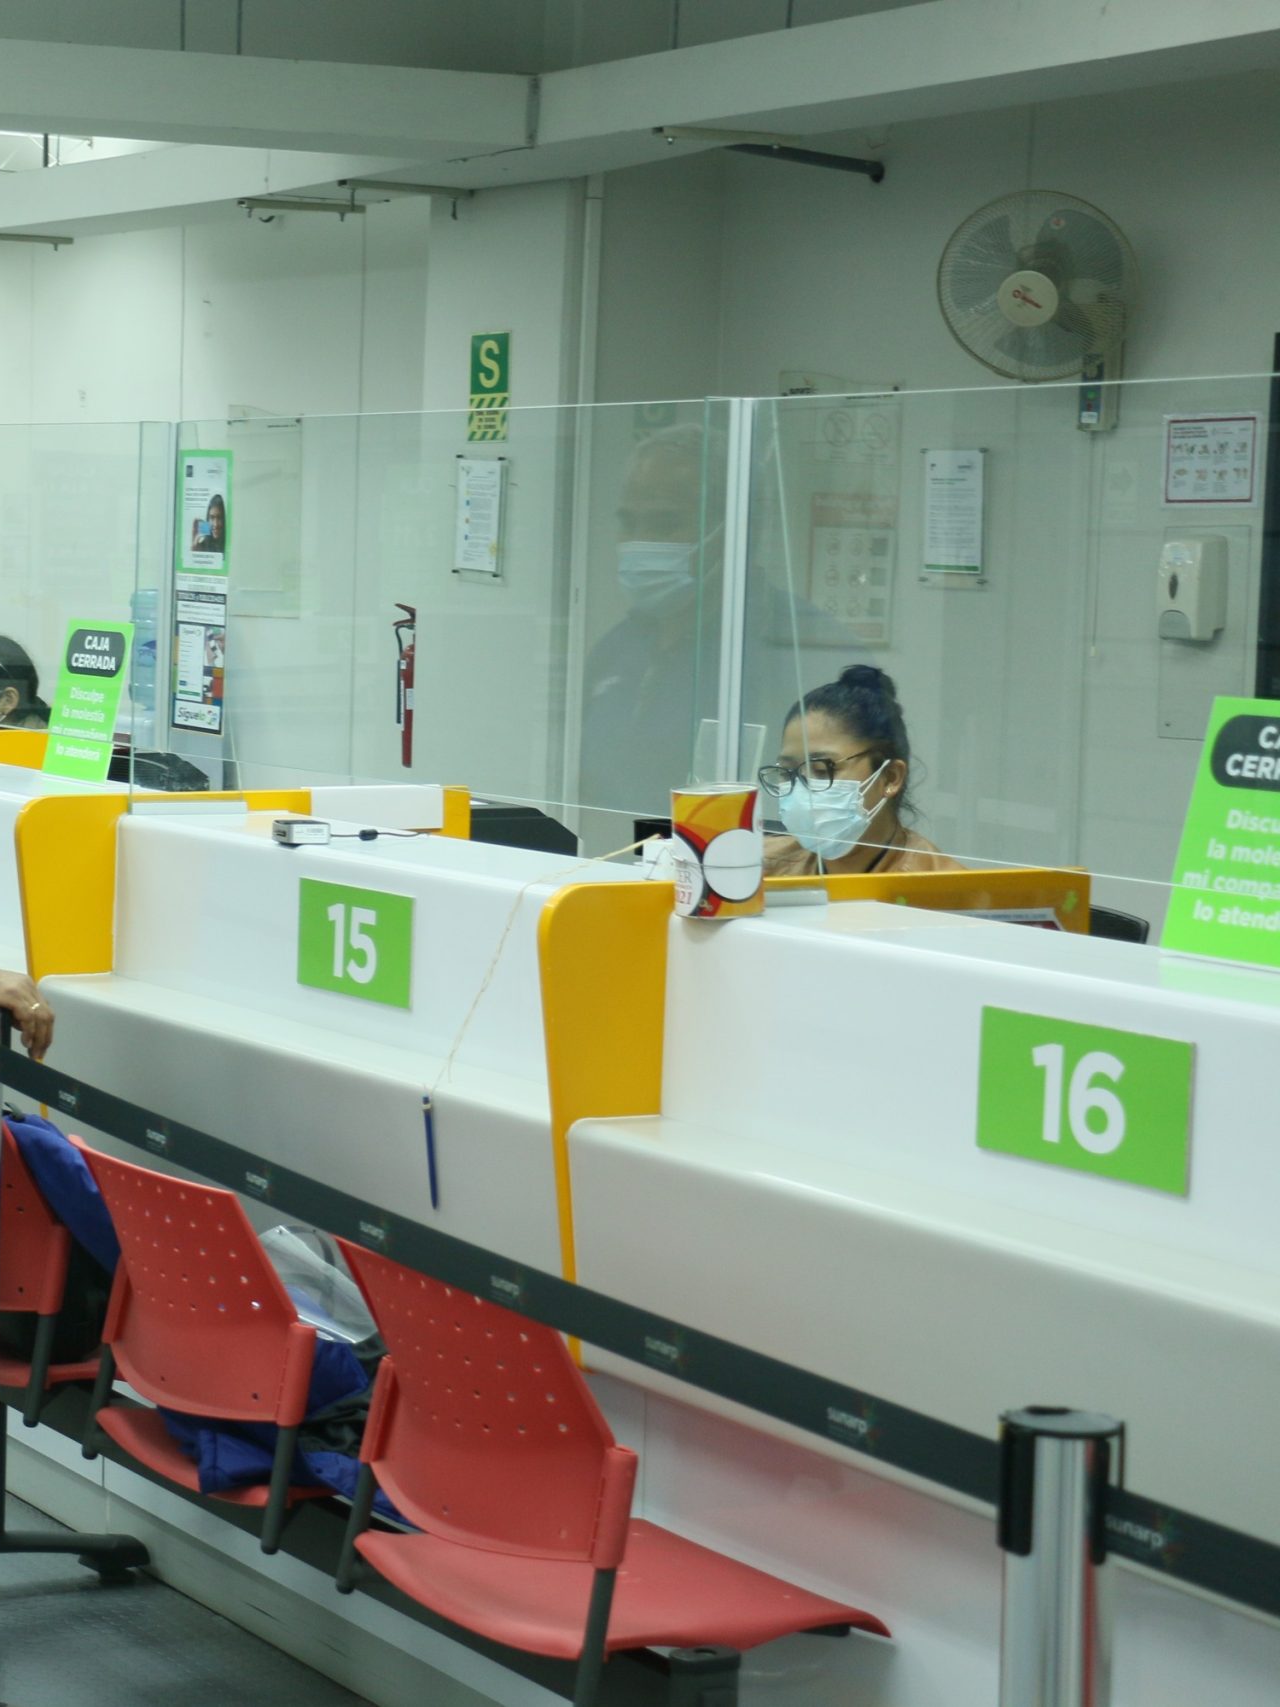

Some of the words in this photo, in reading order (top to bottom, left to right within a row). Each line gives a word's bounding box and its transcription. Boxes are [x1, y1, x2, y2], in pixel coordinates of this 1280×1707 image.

[479, 339, 500, 388] S
[84, 635, 110, 651] CAJA
[71, 653, 116, 671] CERRADA
[70, 687, 105, 704] Disculpe
[61, 704, 70, 718] la
[72, 707, 105, 723] molestia
[56, 742, 66, 756] lo
[1207, 838, 1227, 860] la
[1182, 868, 1210, 889] mi
[1192, 899, 1214, 921] lo
[327, 903, 377, 984] 15
[1032, 1043, 1126, 1155] 16
[826, 1406, 869, 1435] sunarp
